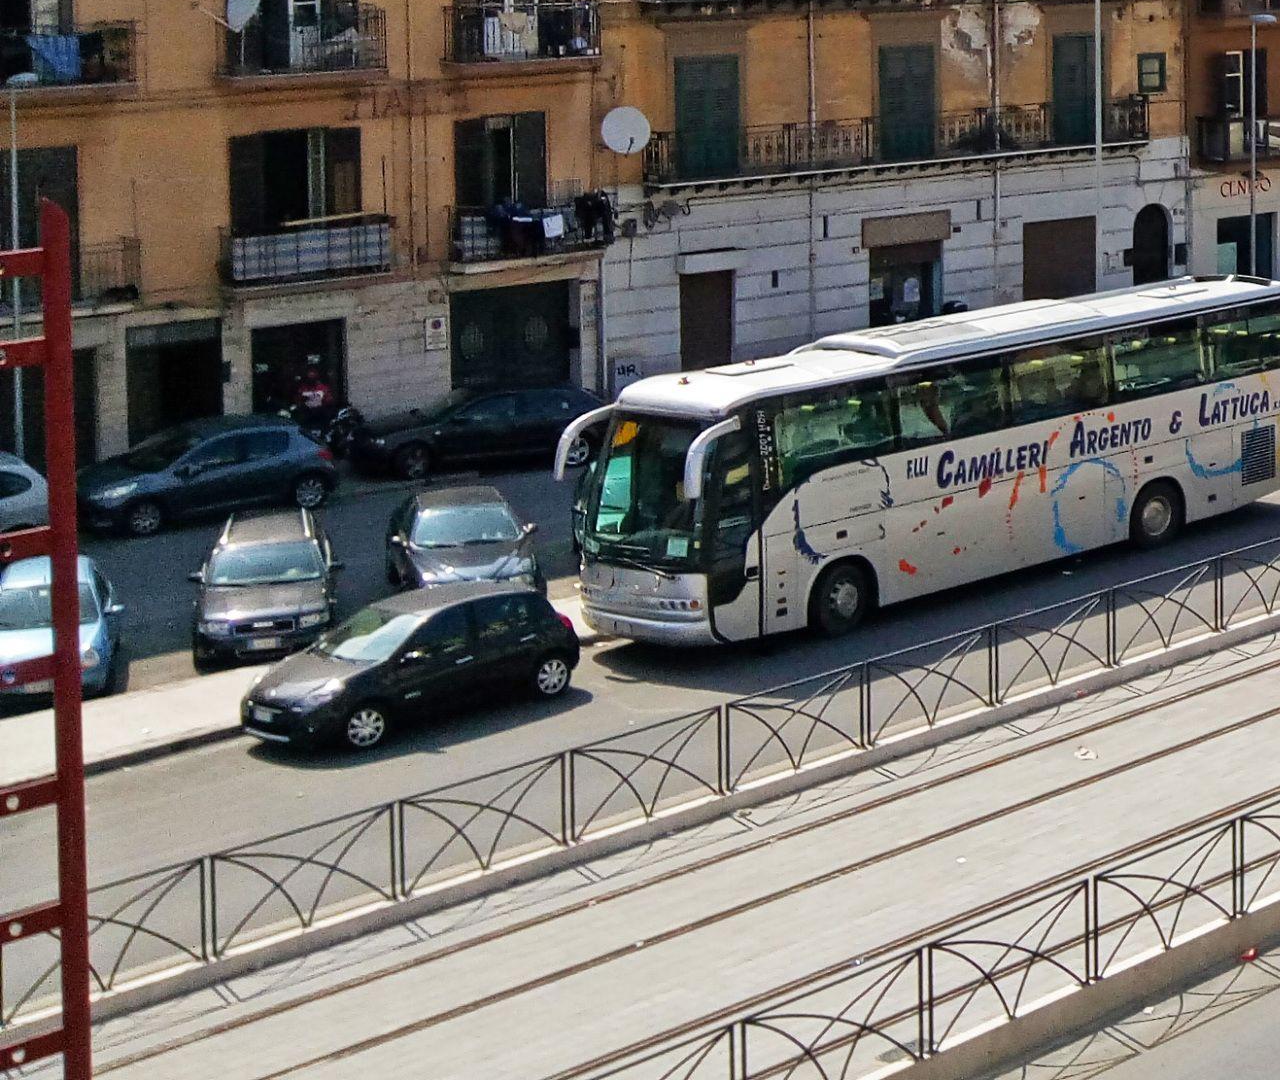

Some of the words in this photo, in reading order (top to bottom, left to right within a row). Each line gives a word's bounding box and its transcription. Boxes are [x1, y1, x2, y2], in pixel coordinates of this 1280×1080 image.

[1220, 176, 1271, 198] CENRO
[937, 440, 1049, 489] CAMILLERI
[1070, 420, 1152, 458] ARGENTO
[1169, 410, 1183, 434] &
[1199, 390, 1270, 427] LATTUCA
